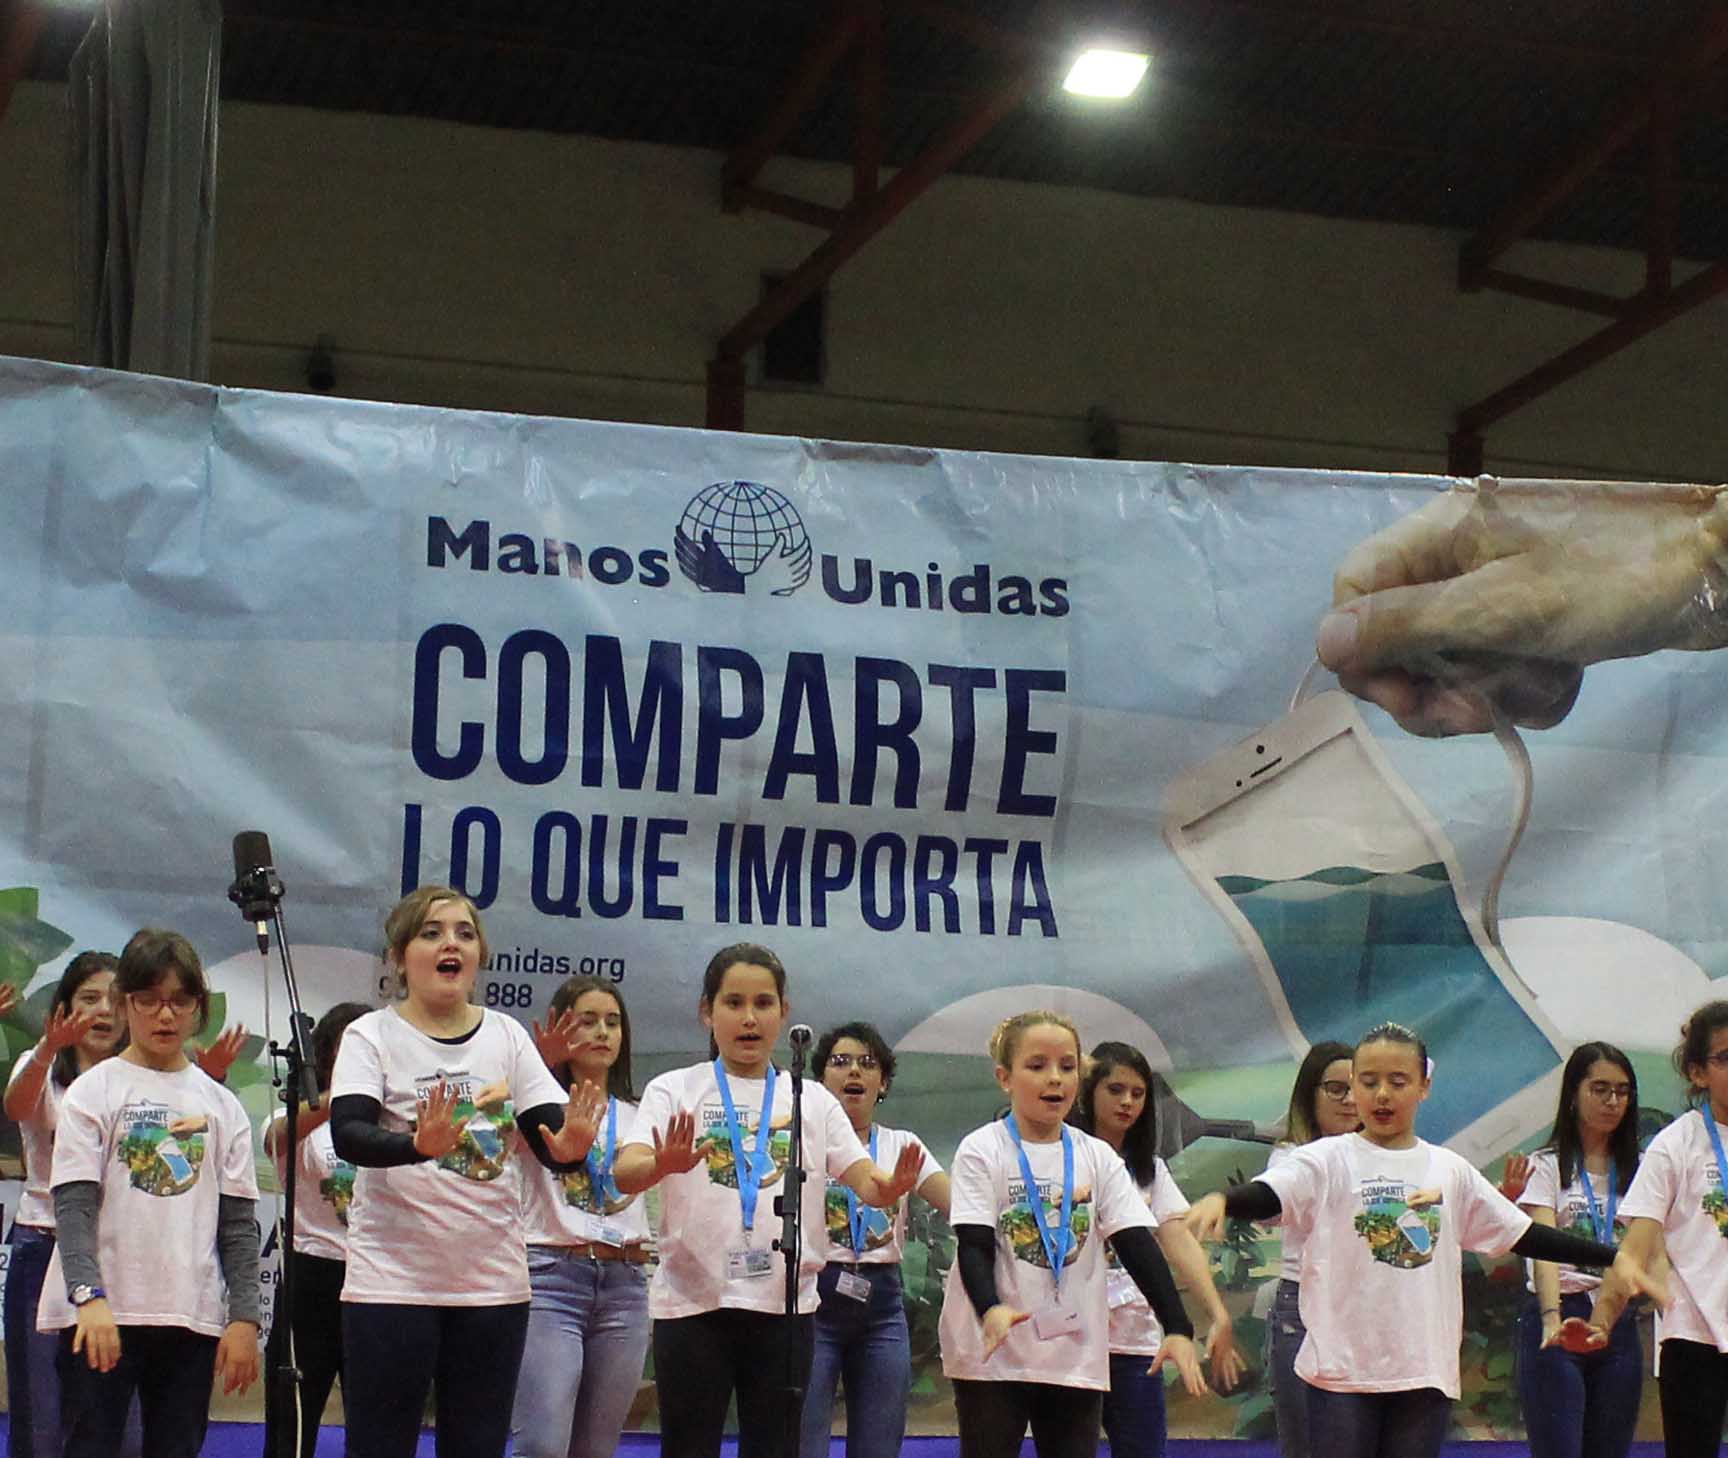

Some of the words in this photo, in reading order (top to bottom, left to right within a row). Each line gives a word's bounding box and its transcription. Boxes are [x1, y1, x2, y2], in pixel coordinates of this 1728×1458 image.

[427, 515, 671, 588] Manos
[822, 554, 1071, 617] Unidas
[411, 623, 1067, 818] COMPARTE
[531, 810, 688, 922] QUE
[715, 822, 1060, 939] IMPORTA
[124, 1111, 168, 1121] COMPARTE
[1361, 1187, 1404, 1197] COMPARTE
